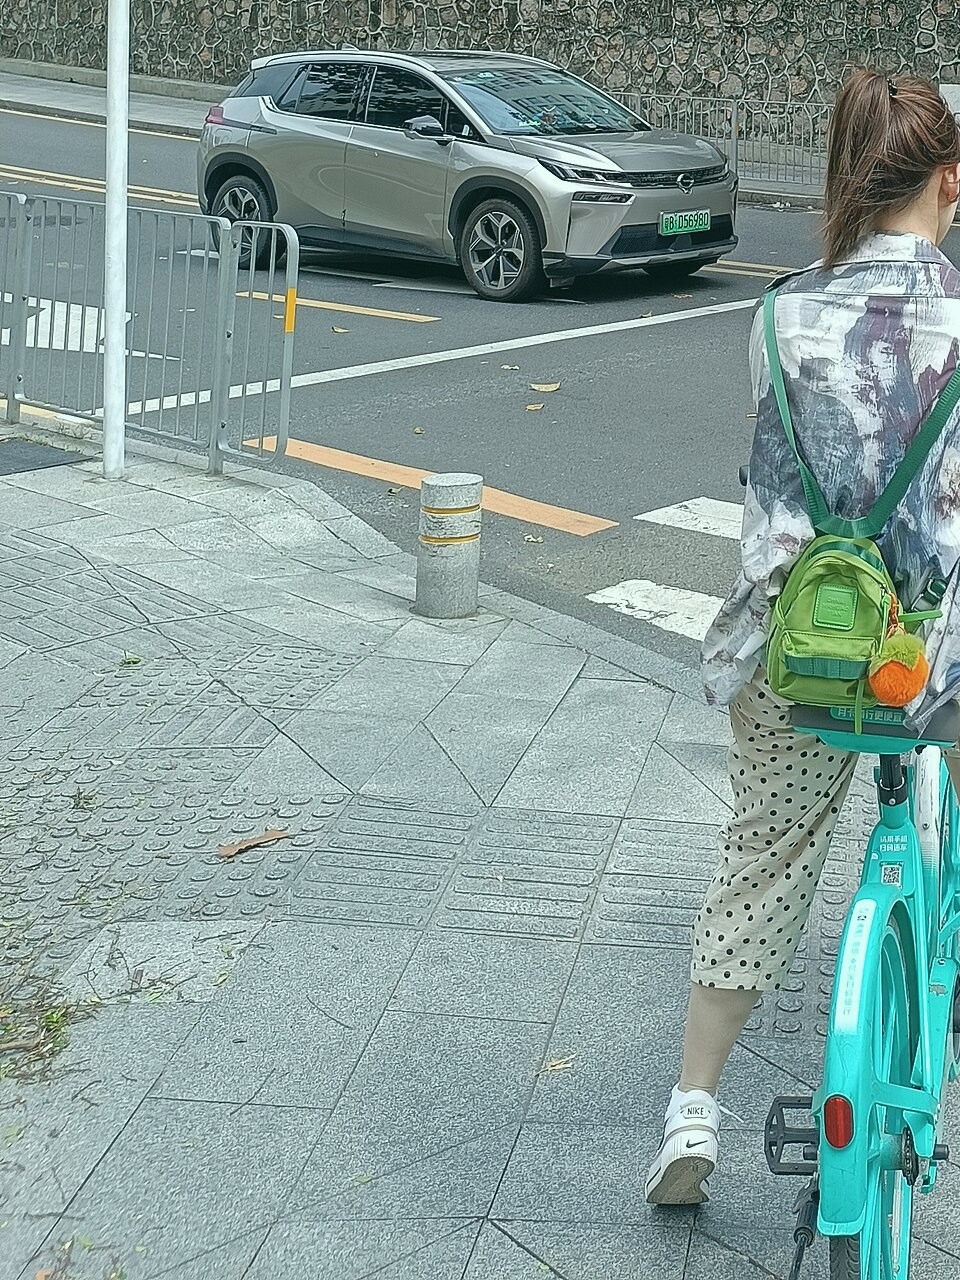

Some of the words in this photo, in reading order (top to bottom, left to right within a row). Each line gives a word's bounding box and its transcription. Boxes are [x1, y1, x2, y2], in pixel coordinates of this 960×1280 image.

[838, 707, 902, 722] 月卡行更便宜
[687, 1107, 704, 1115] NIKE
